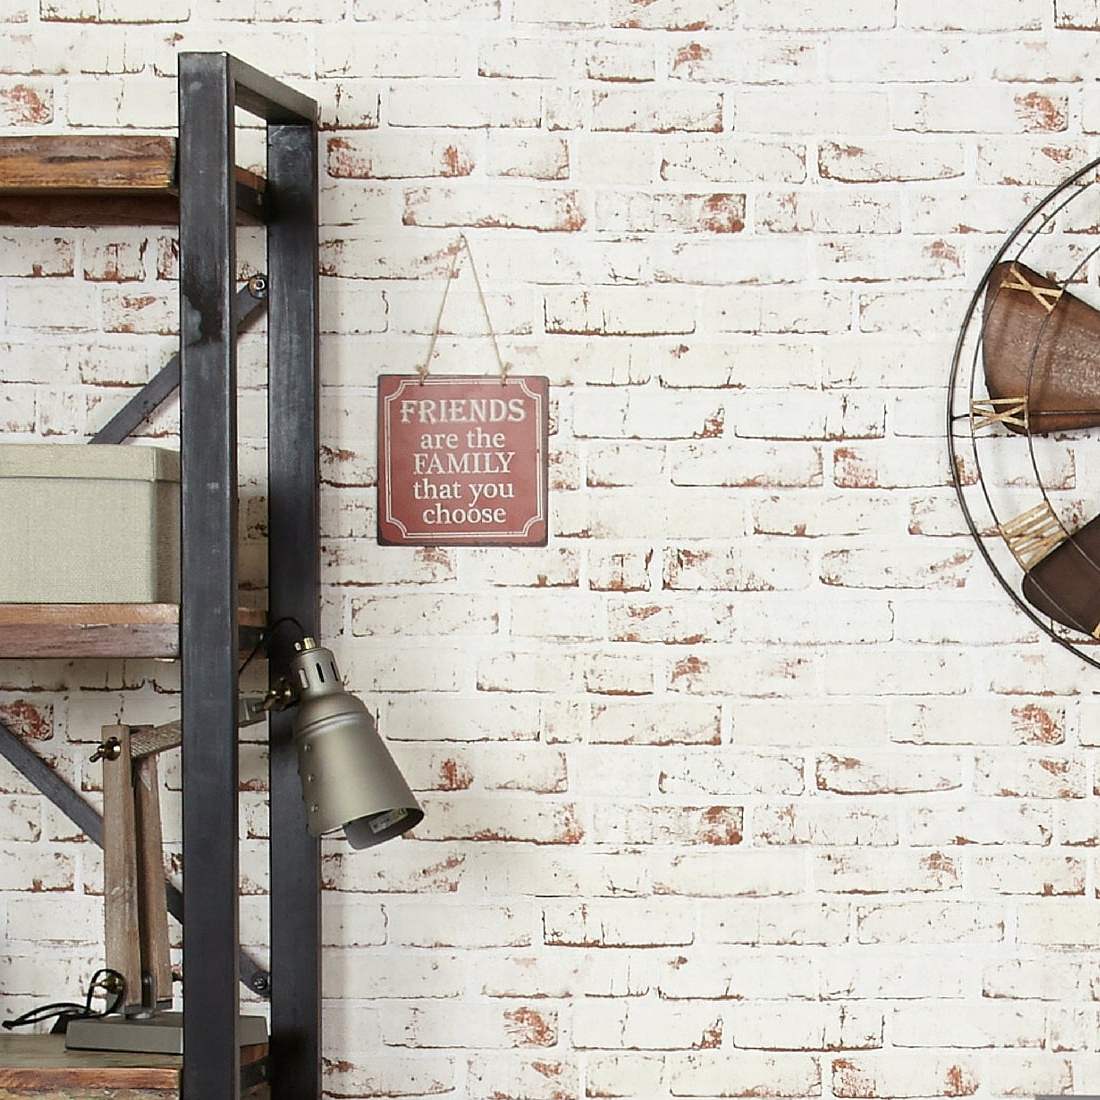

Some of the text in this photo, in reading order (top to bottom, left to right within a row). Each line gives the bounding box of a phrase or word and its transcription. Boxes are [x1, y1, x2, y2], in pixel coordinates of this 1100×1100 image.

[400, 399, 526, 424] FRIENDS
[420, 426, 506, 450] are the
[413, 451, 516, 475] FAMILY
[413, 478, 515, 507] that you
[422, 503, 507, 525] choose
